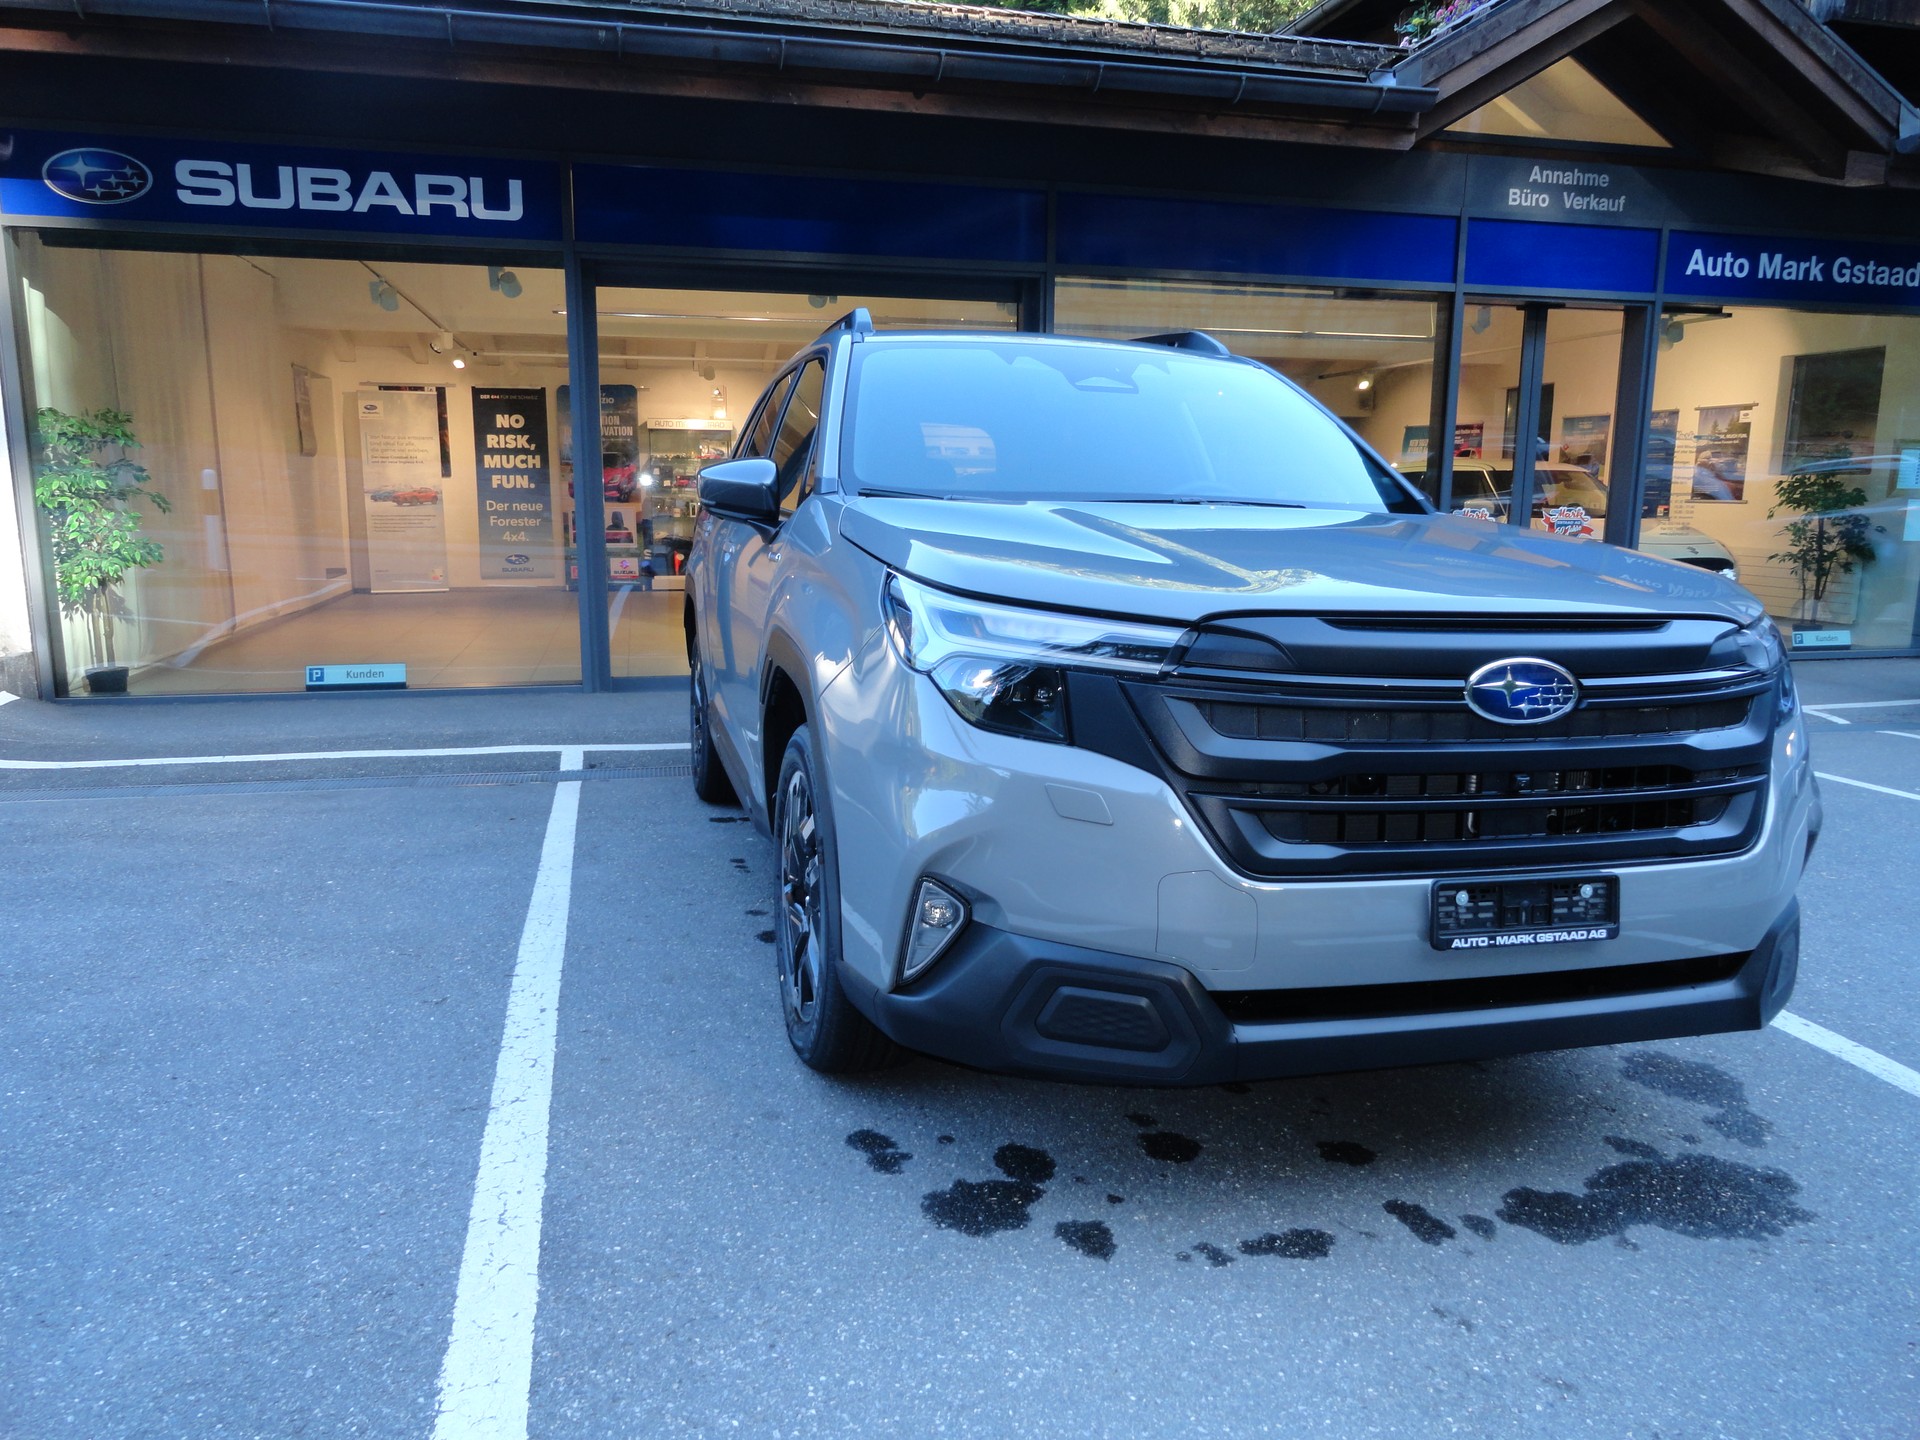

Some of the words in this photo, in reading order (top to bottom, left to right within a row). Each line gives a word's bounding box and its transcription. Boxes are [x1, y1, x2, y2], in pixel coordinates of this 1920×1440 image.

[1528, 165, 1610, 187] Annahme
[174, 159, 524, 222] SUBARU
[1508, 188, 1550, 208] Büro
[1563, 191, 1626, 212] Verkauf
[1685, 248, 1750, 278] Auto
[1757, 252, 1825, 282] Mark
[1832, 256, 1920, 288] Gstaad
[495, 413, 525, 429] NO
[654, 420, 674, 428] AUTO
[486, 434, 536, 451] RISK,
[483, 454, 541, 469] MUCH
[491, 474, 536, 489] FUN.
[486, 500, 510, 511] Der
[512, 502, 544, 511] neue
[489, 515, 542, 527] Forester
[1554, 507, 1589, 520] Mark
[502, 531, 530, 542] 4x4.
[1815, 634, 1839, 642] Kunden
[346, 669, 385, 679] Kunden
[1451, 936, 1489, 948] AUTO
[1496, 933, 1535, 946] MARK
[1536, 930, 1588, 943] GSTAAD
[1588, 929, 1607, 940] AG
